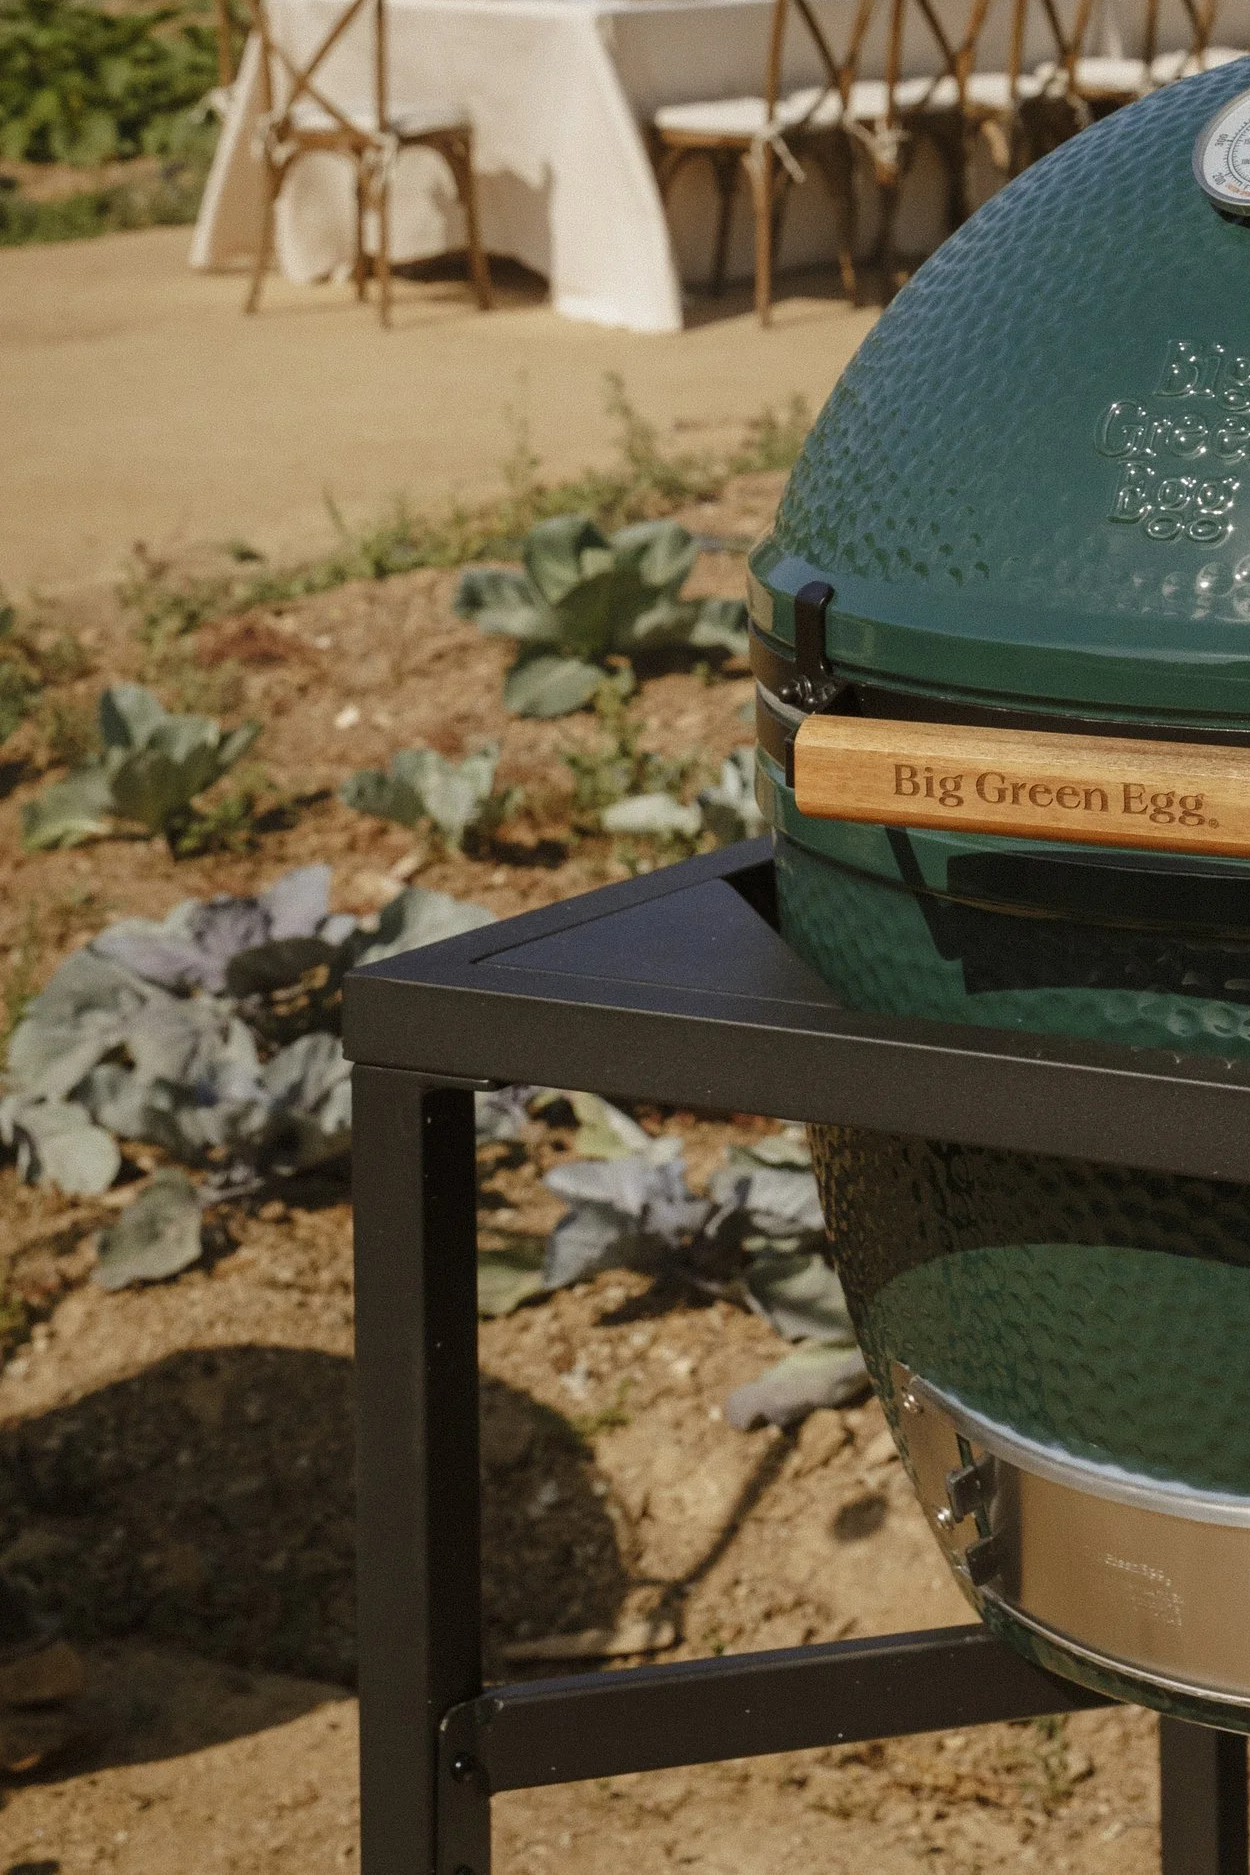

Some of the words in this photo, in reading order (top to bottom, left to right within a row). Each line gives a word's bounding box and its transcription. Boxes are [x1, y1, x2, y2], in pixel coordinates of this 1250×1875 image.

[1215, 133, 1229, 147] 300
[1106, 460, 1240, 550] Egg
[893, 763, 963, 808] Big
[976, 771, 1109, 813] Green
